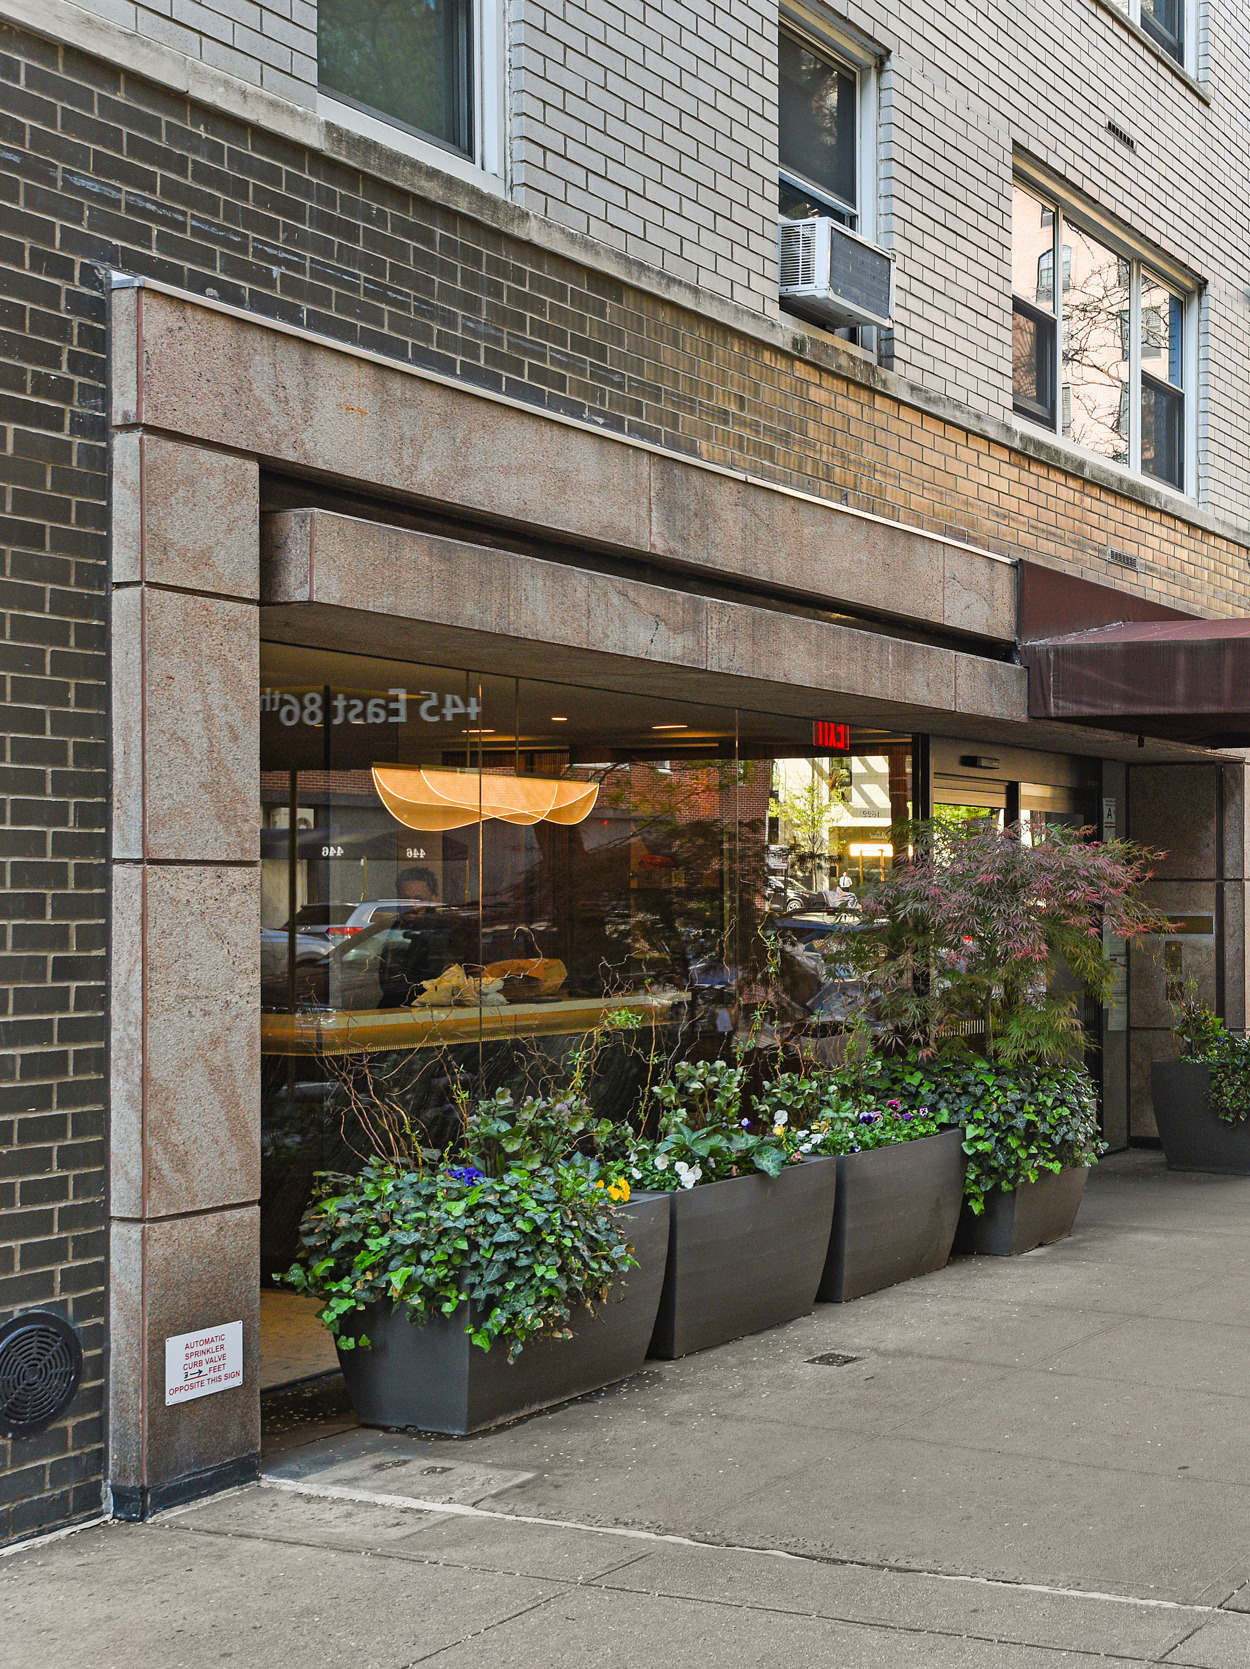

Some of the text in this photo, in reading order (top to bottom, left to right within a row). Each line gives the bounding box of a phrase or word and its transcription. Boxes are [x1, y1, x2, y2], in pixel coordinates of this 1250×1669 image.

[184, 1333, 226, 1351] AUTOMATIC
[184, 1343, 225, 1361] SPRINKLER
[182, 1353, 227, 1371] CURB VALVE
[208, 1363, 227, 1375] FEET
[168, 1370, 241, 1396] OPPOSITE THIS SIGN
